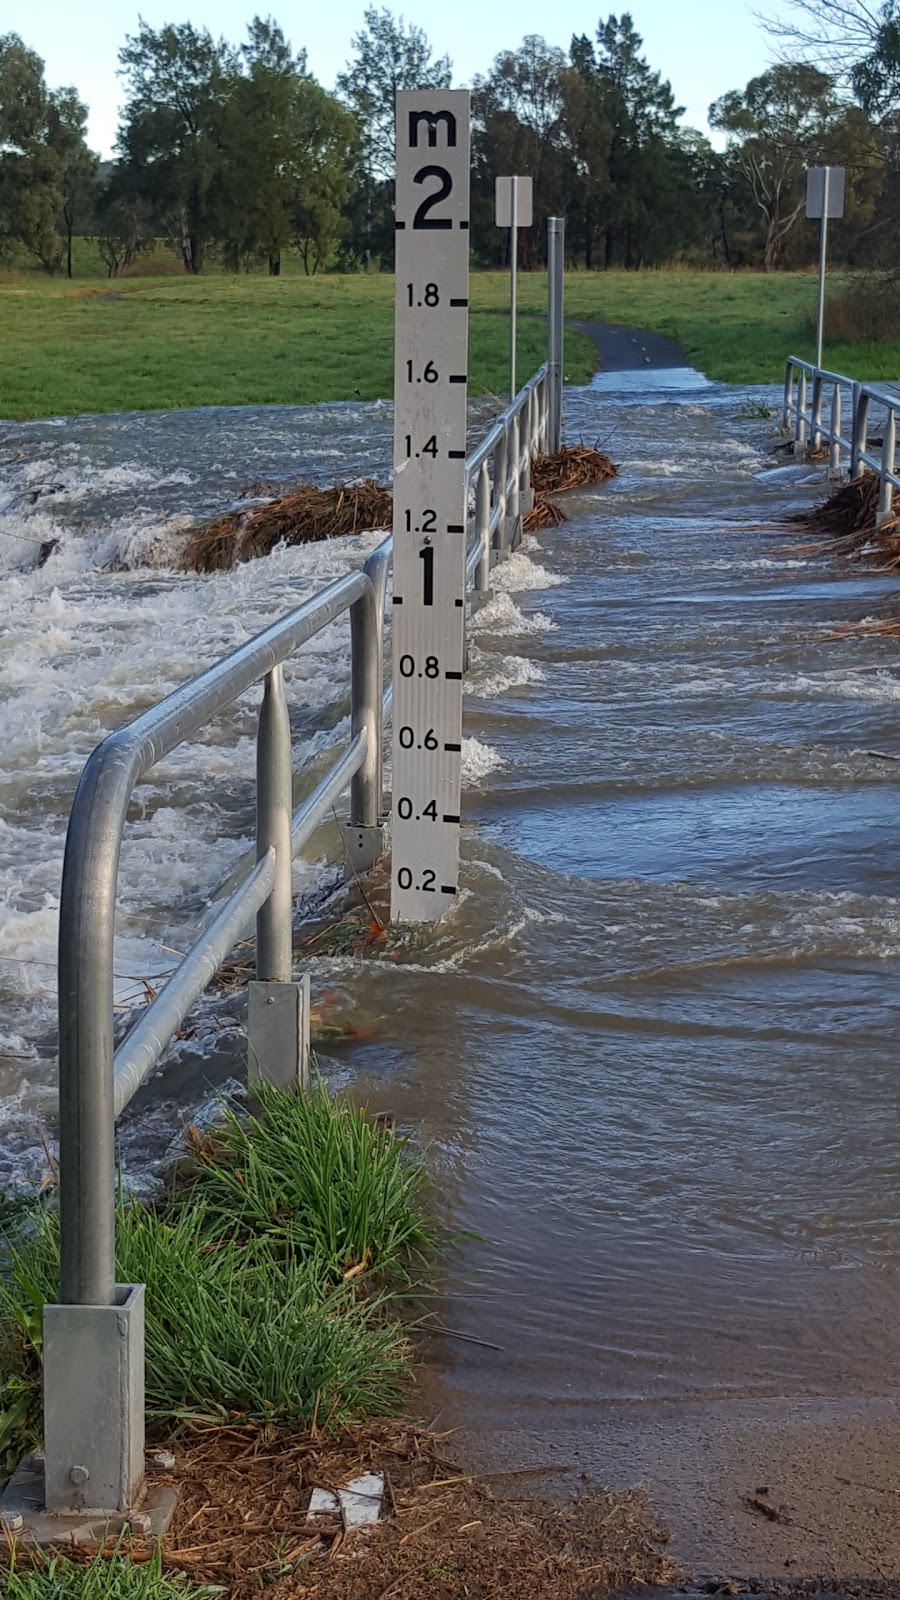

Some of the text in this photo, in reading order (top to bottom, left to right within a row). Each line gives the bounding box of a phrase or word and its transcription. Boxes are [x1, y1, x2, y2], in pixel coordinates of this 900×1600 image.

[409, 110, 457, 147] m
[413, 165, 453, 230] 2
[406, 283, 440, 308] 1.8
[406, 359, 439, 384] 1.6
[405, 435, 438, 459] 1.4
[405, 509, 437, 533] 1.2
[419, 547, 434, 606] 1
[399, 655, 440, 680] 0.8
[398, 726, 439, 751] 0.6
[397, 797, 438, 822] 0.4
[397, 867, 436, 893] 0.2
